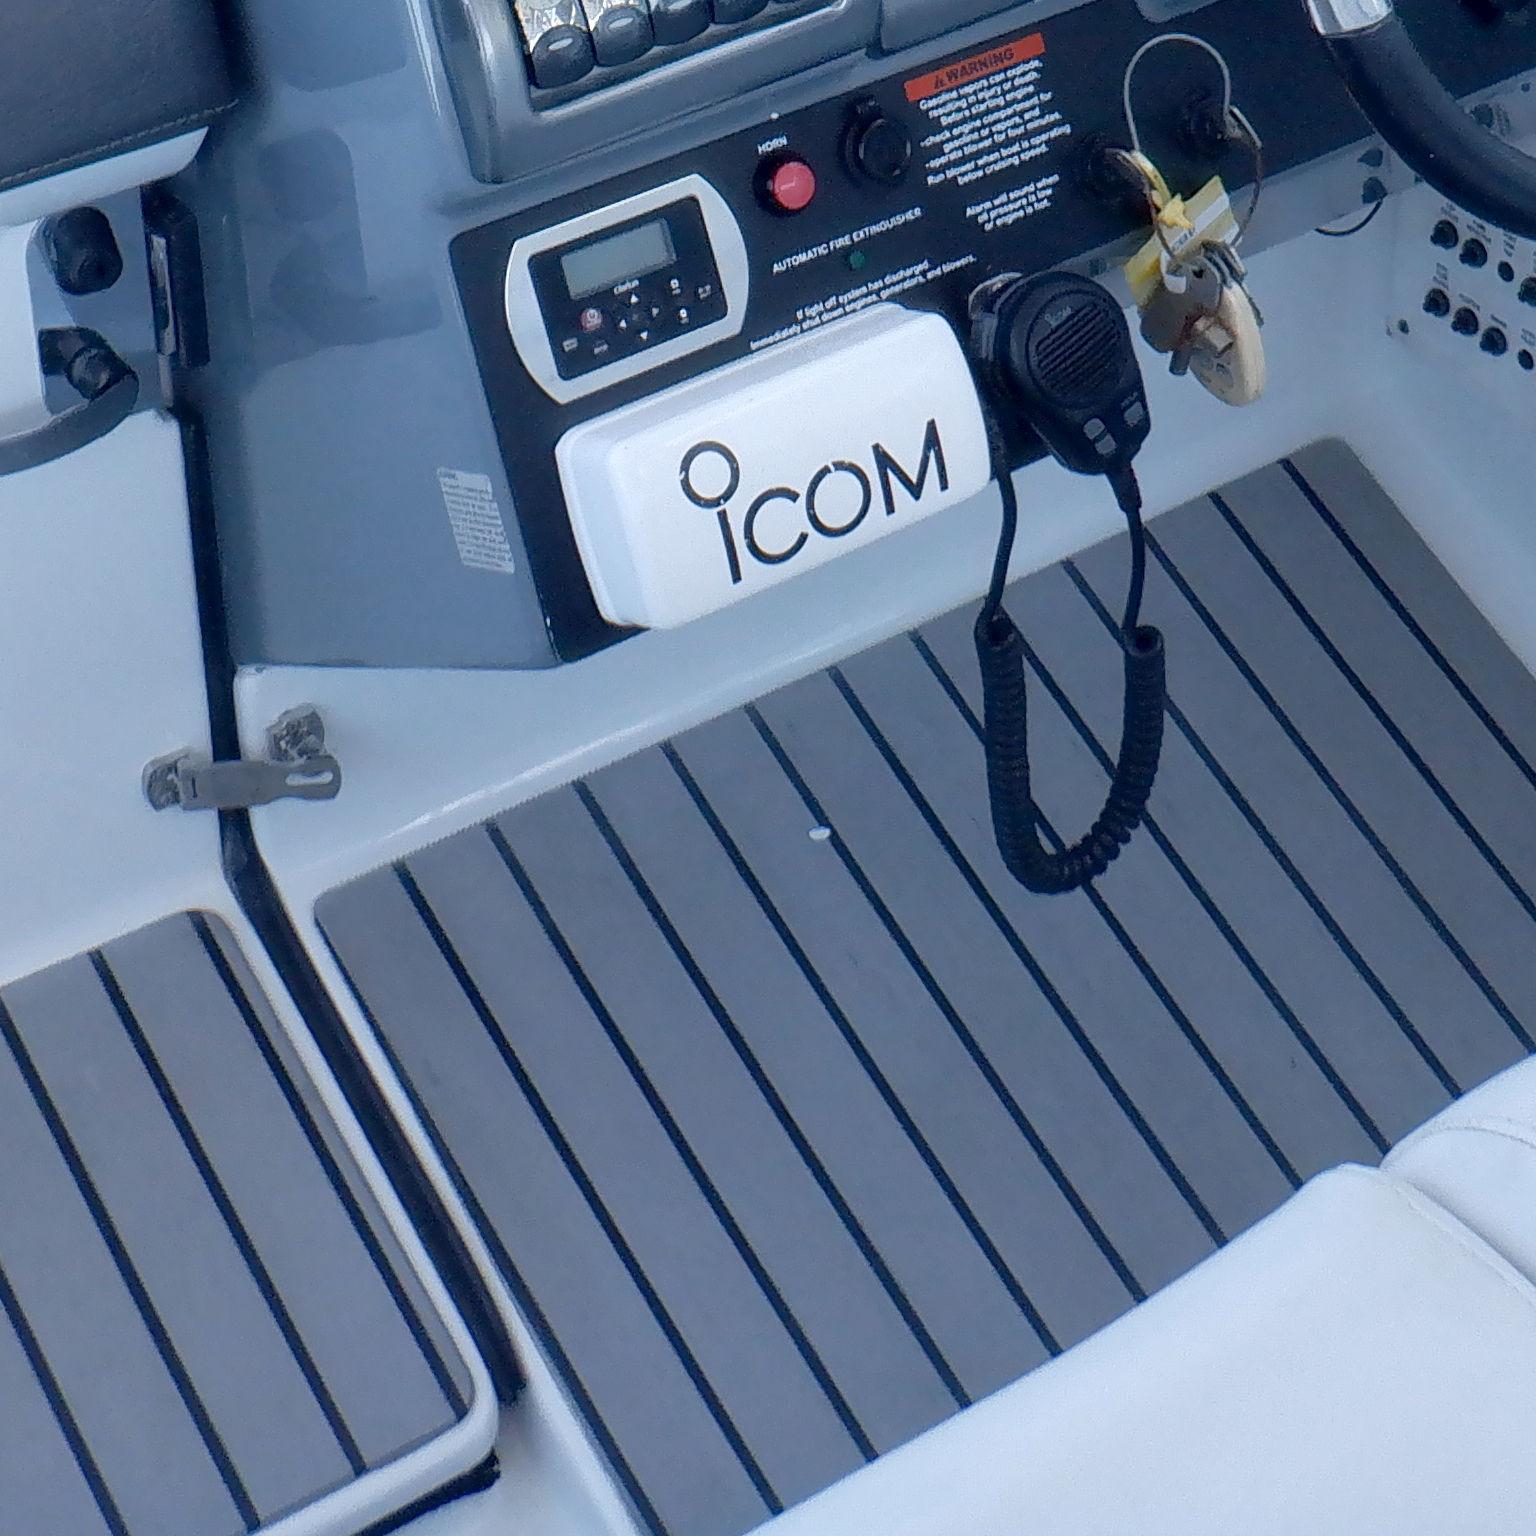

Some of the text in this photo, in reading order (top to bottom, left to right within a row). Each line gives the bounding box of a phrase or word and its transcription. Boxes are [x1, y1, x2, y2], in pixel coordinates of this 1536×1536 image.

[945, 47, 1015, 83] WARNING
[989, 73, 1005, 84] can
[758, 136, 787, 154] HORN
[773, 208, 921, 273] AUTOMATIC FIRE EXTINGUISHER
